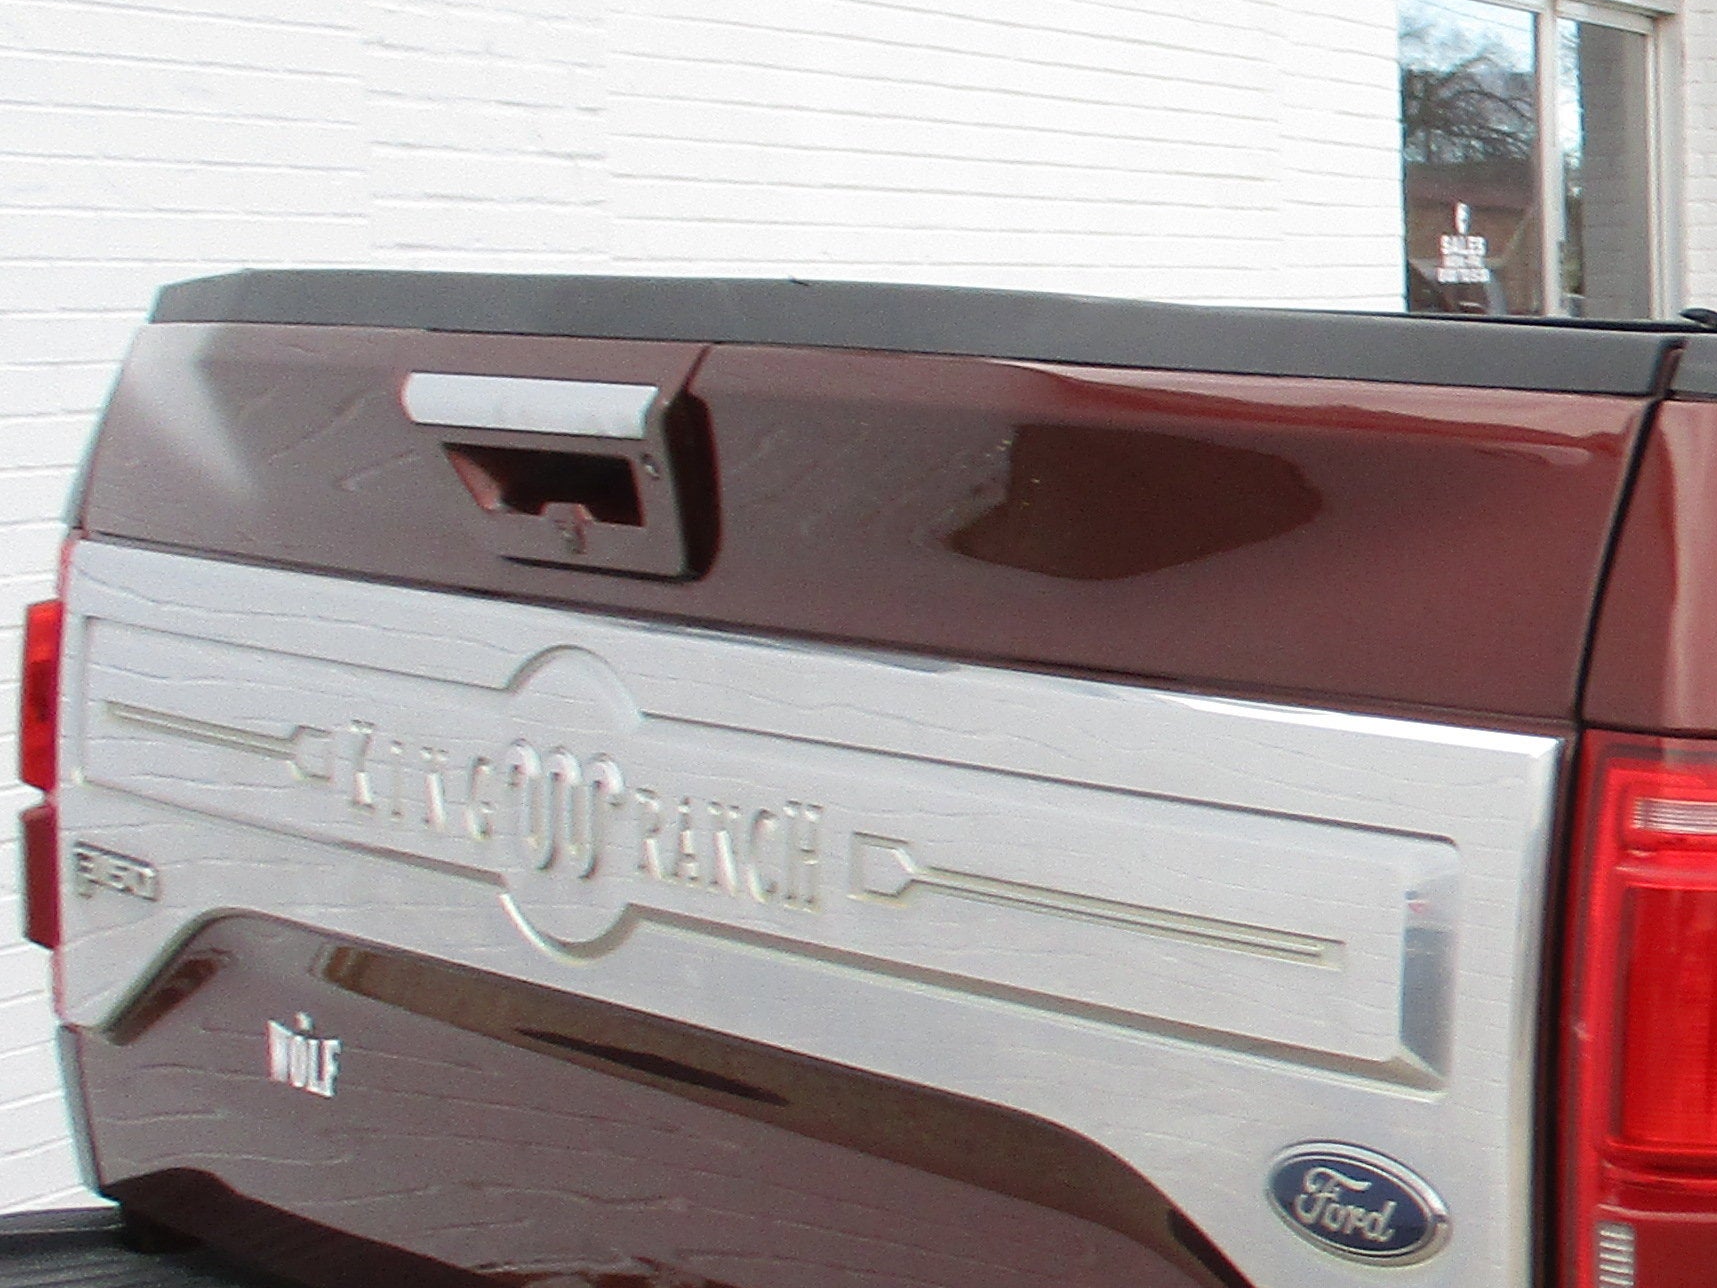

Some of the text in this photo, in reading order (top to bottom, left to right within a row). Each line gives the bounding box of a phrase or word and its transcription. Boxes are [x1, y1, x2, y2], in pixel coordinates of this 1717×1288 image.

[346, 719, 825, 914] KING RANCH
[266, 1019, 343, 1098] WOLF
[1293, 1166, 1398, 1243] Ford
